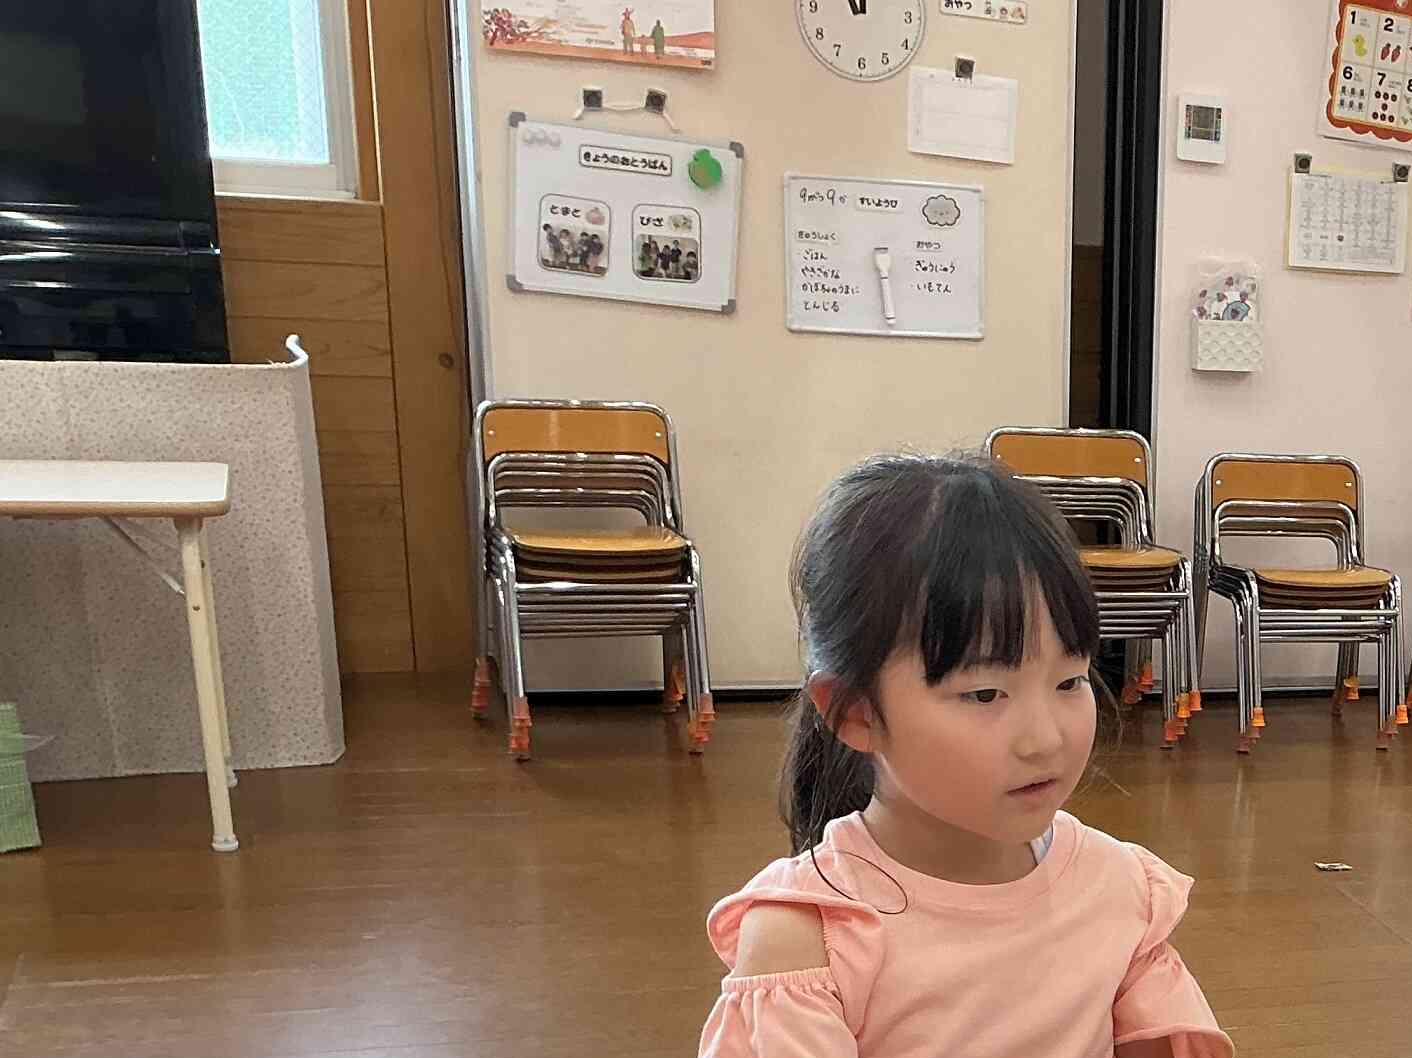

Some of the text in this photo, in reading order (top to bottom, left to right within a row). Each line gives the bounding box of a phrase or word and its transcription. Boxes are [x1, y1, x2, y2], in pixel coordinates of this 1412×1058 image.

[808, 0, 818, 13] 9
[904, 11, 912, 24] 3
[1350, 10, 1356, 24] 1
[1383, 18, 1394, 32] 2
[815, 28, 824, 40] 8
[833, 44, 841, 57] 7
[900, 38, 909, 50] 4
[857, 57, 866, 69] 6
[881, 53, 889, 65] 5
[1342, 66, 1353, 80] 6
[1377, 73, 1386, 86] 7
[583, 151, 668, 171] きょうのおとうばん
[550, 204, 582, 218] とまと
